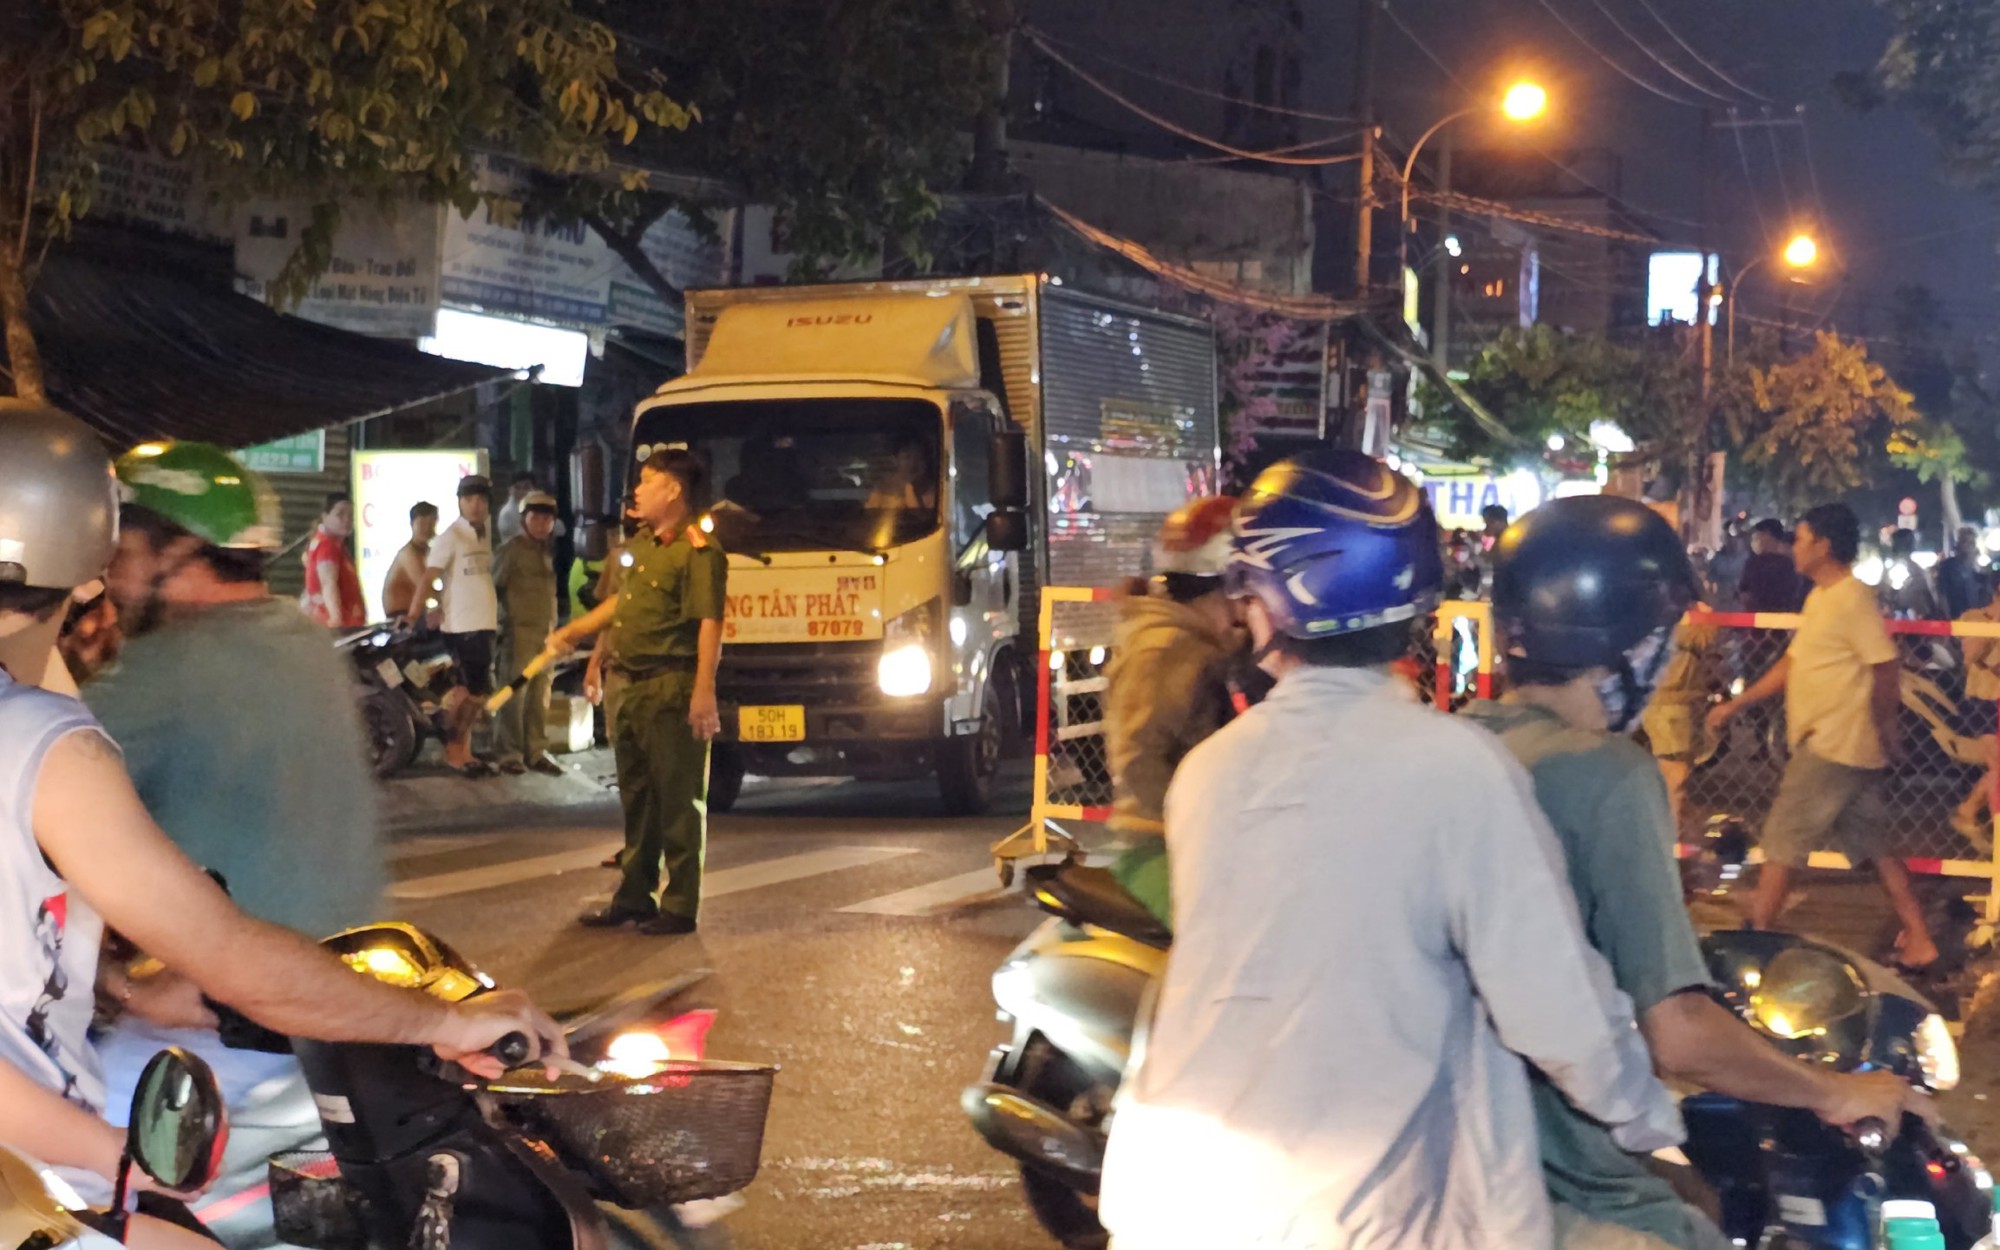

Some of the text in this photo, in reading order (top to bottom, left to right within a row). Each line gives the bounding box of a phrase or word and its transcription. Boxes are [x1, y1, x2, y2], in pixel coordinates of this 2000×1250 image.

[787, 314, 872, 328] ISUZU
[758, 588, 797, 618] TÂN
[805, 588, 860, 617] PHÁT
[758, 707, 786, 724] 50H
